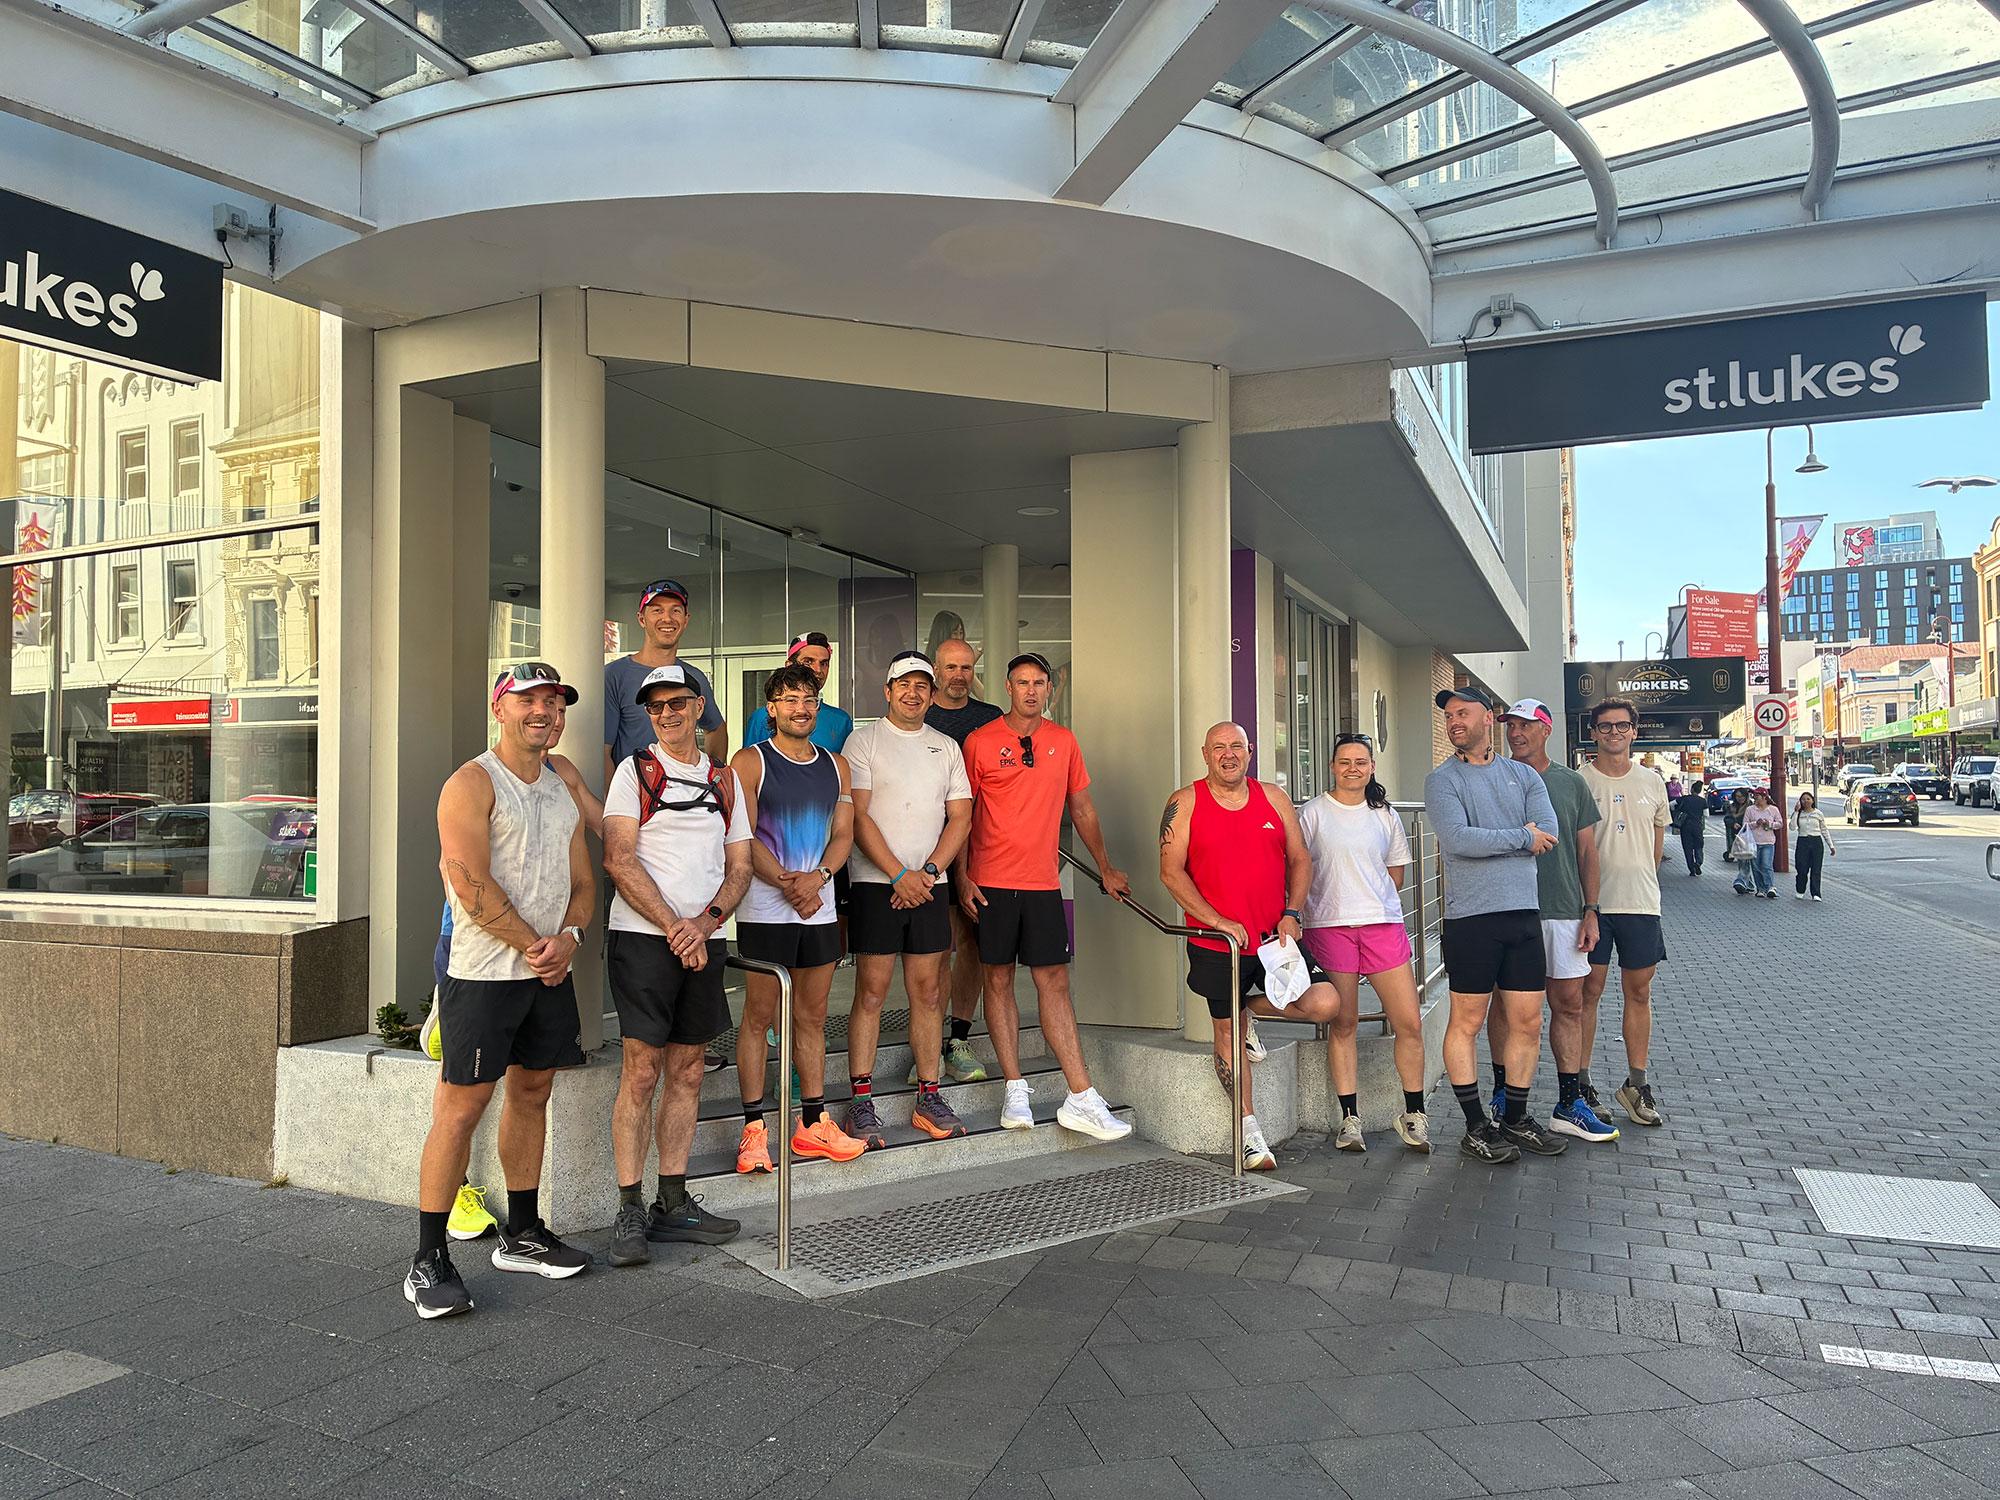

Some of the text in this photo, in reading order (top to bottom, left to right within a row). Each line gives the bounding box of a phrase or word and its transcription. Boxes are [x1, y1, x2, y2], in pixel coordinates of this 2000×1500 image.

[1664, 353, 1900, 415] st.lukes
[1691, 593, 1720, 606] For Sale
[1617, 679, 1690, 692] WORKERS
[1760, 708, 1784, 722] 40
[80, 757, 104, 765] HEALTH
[1000, 758, 1016, 766] EPIC
[473, 1048, 481, 1078] SALOMON
